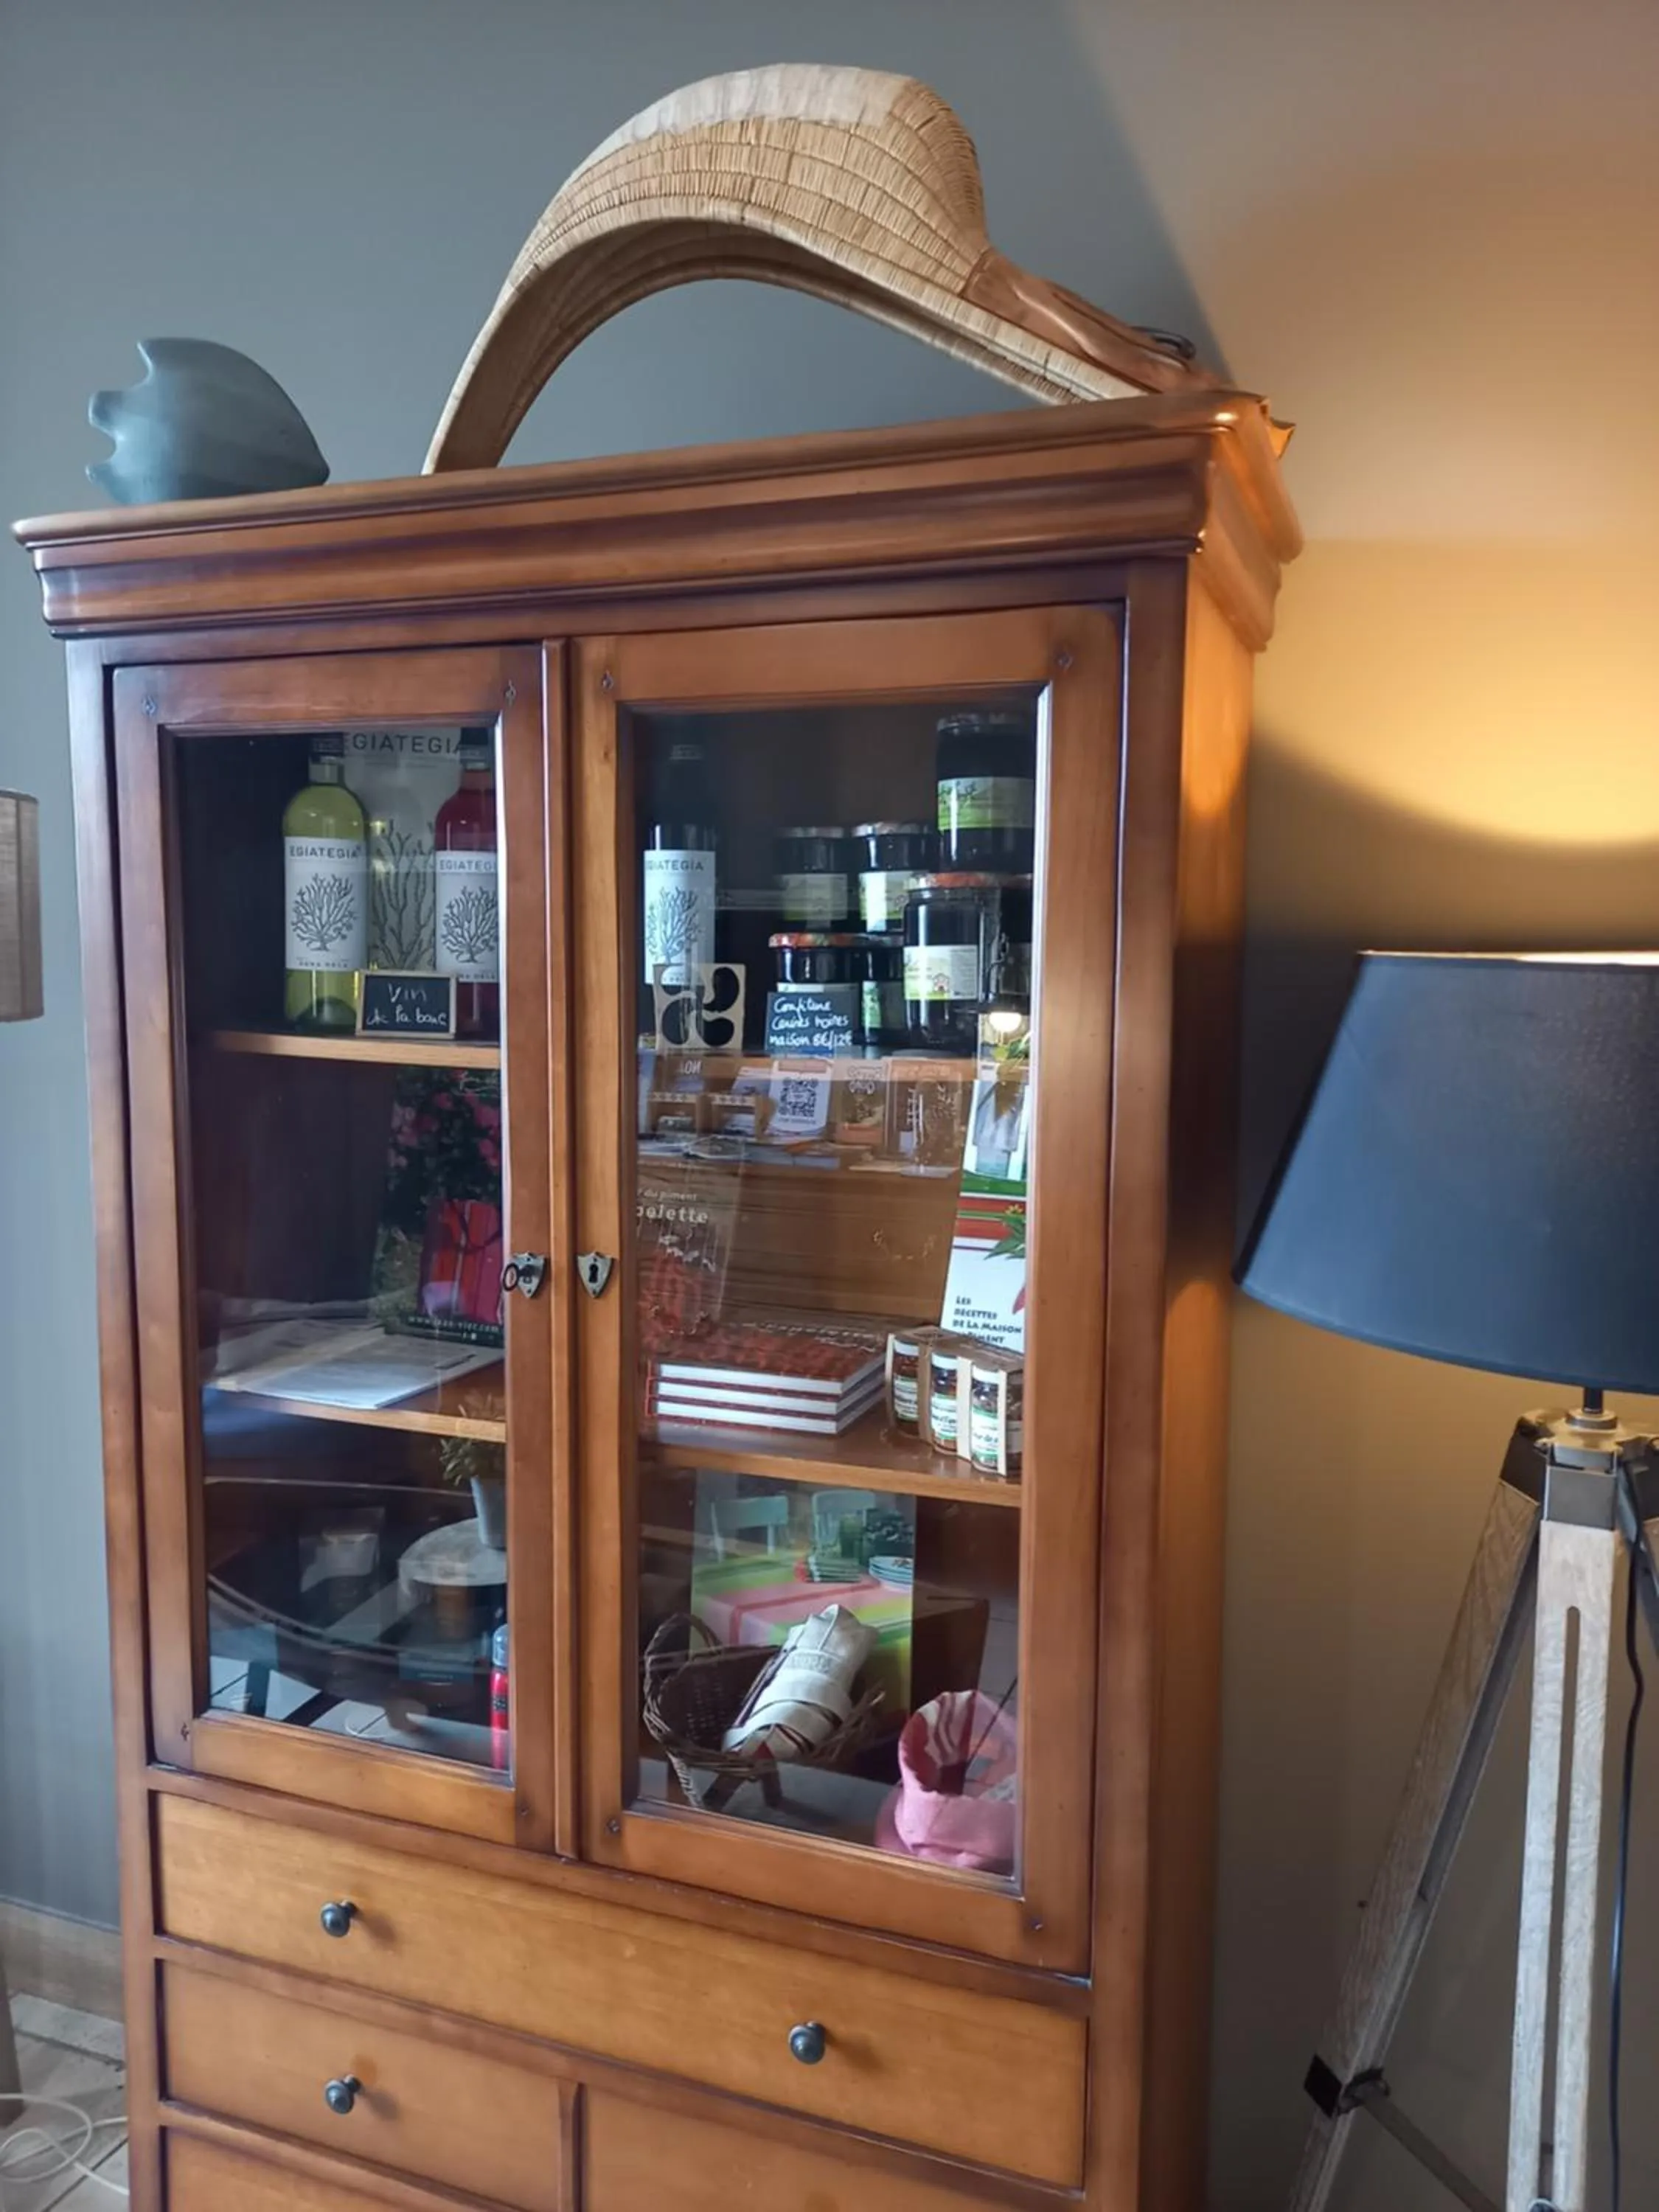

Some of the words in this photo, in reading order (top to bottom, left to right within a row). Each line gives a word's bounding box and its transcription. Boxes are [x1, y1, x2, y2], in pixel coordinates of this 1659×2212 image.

[289, 845, 358, 859] EGIATEGIA
[439, 859, 497, 872] EGIATEGI
[388, 982, 427, 1003] Vin
[769, 1032, 811, 1047] maison
[955, 1295, 972, 1305] LES
[952, 1319, 964, 1328] DE
[967, 1320, 979, 1329] LA
[981, 1323, 1022, 1334] MAISON
